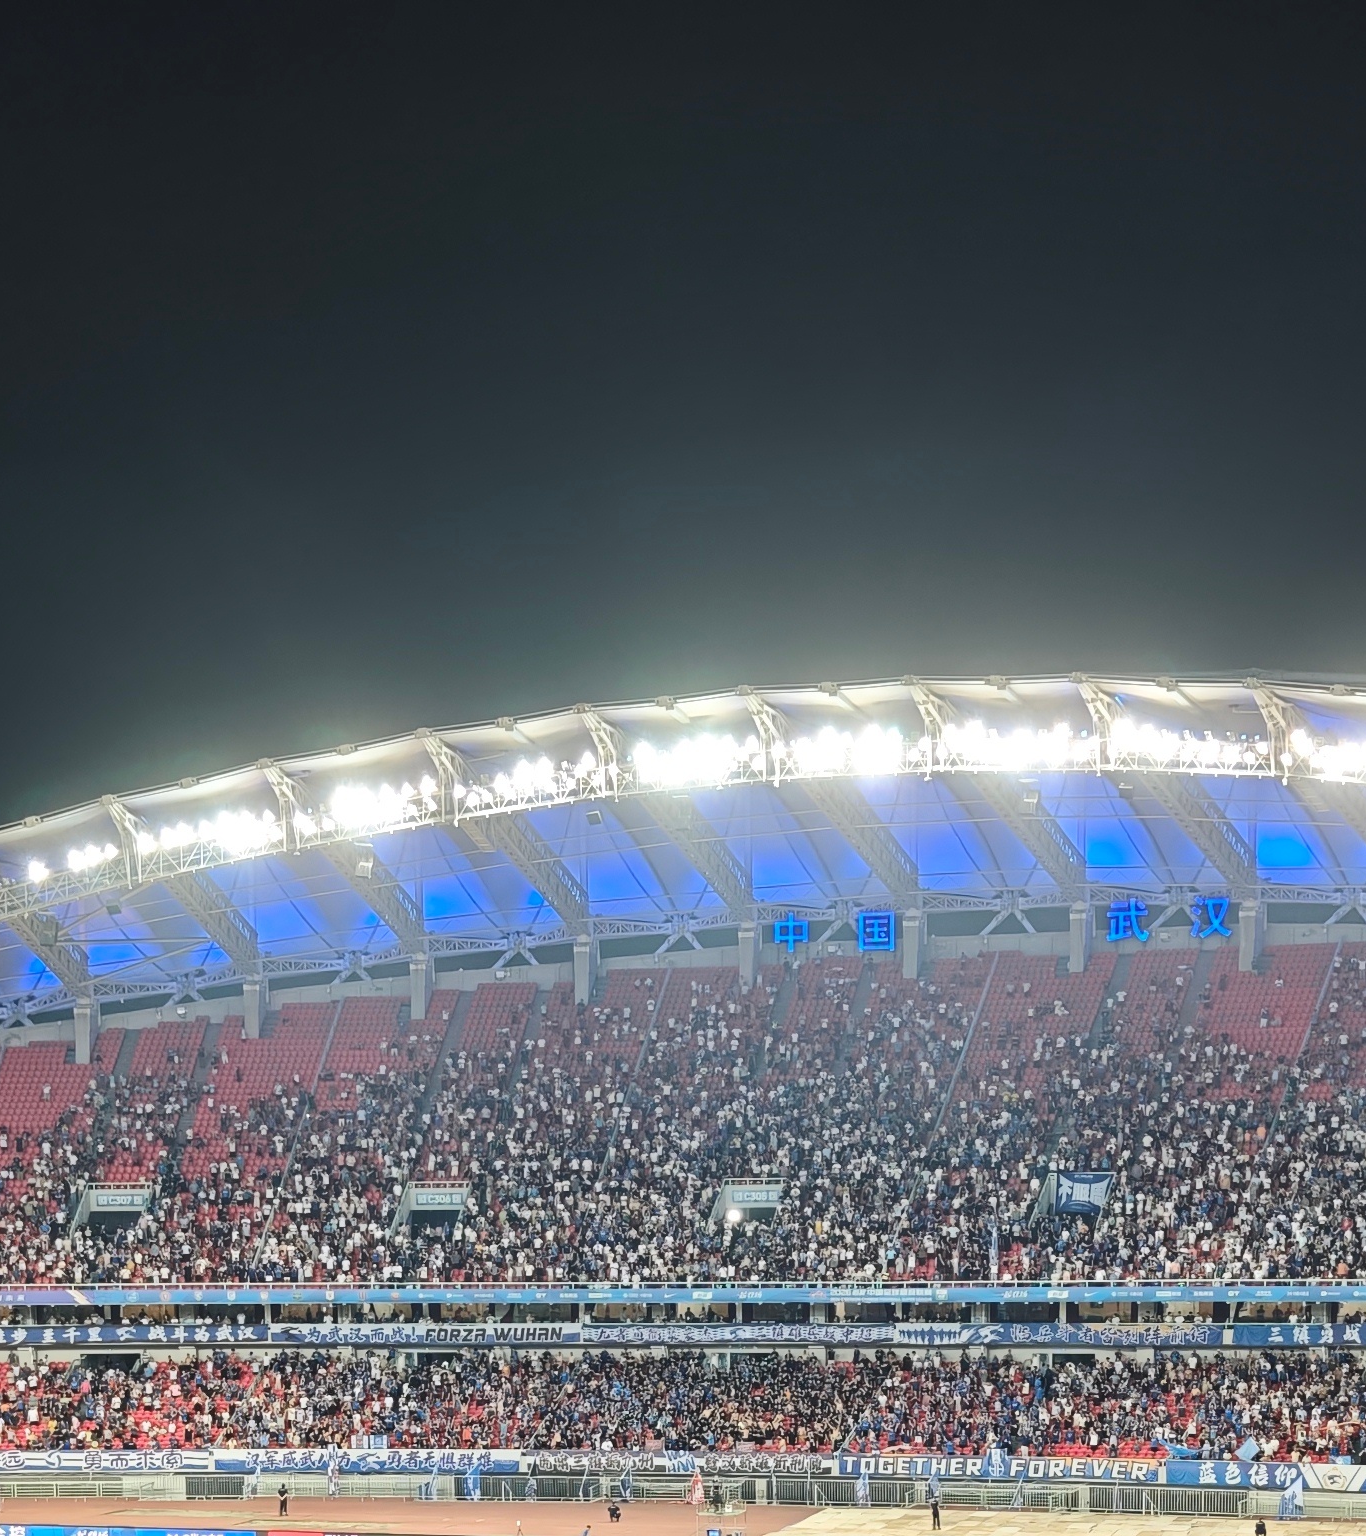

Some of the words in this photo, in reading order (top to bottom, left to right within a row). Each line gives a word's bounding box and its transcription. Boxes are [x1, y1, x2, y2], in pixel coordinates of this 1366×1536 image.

[773, 911, 896, 953] 中国
[1105, 896, 1233, 942] 武汉
[108, 1195, 132, 1205] C307
[427, 1194, 452, 1205] C306
[147, 1325, 259, 1343] 战斗为武汉
[424, 1327, 487, 1343] FORZA
[493, 1326, 564, 1342] WUHAN
[842, 1455, 983, 1477] TOGETHER
[1009, 1458, 1153, 1482] FOREVER
[1197, 1462, 1302, 1487] 蓝色信仰
